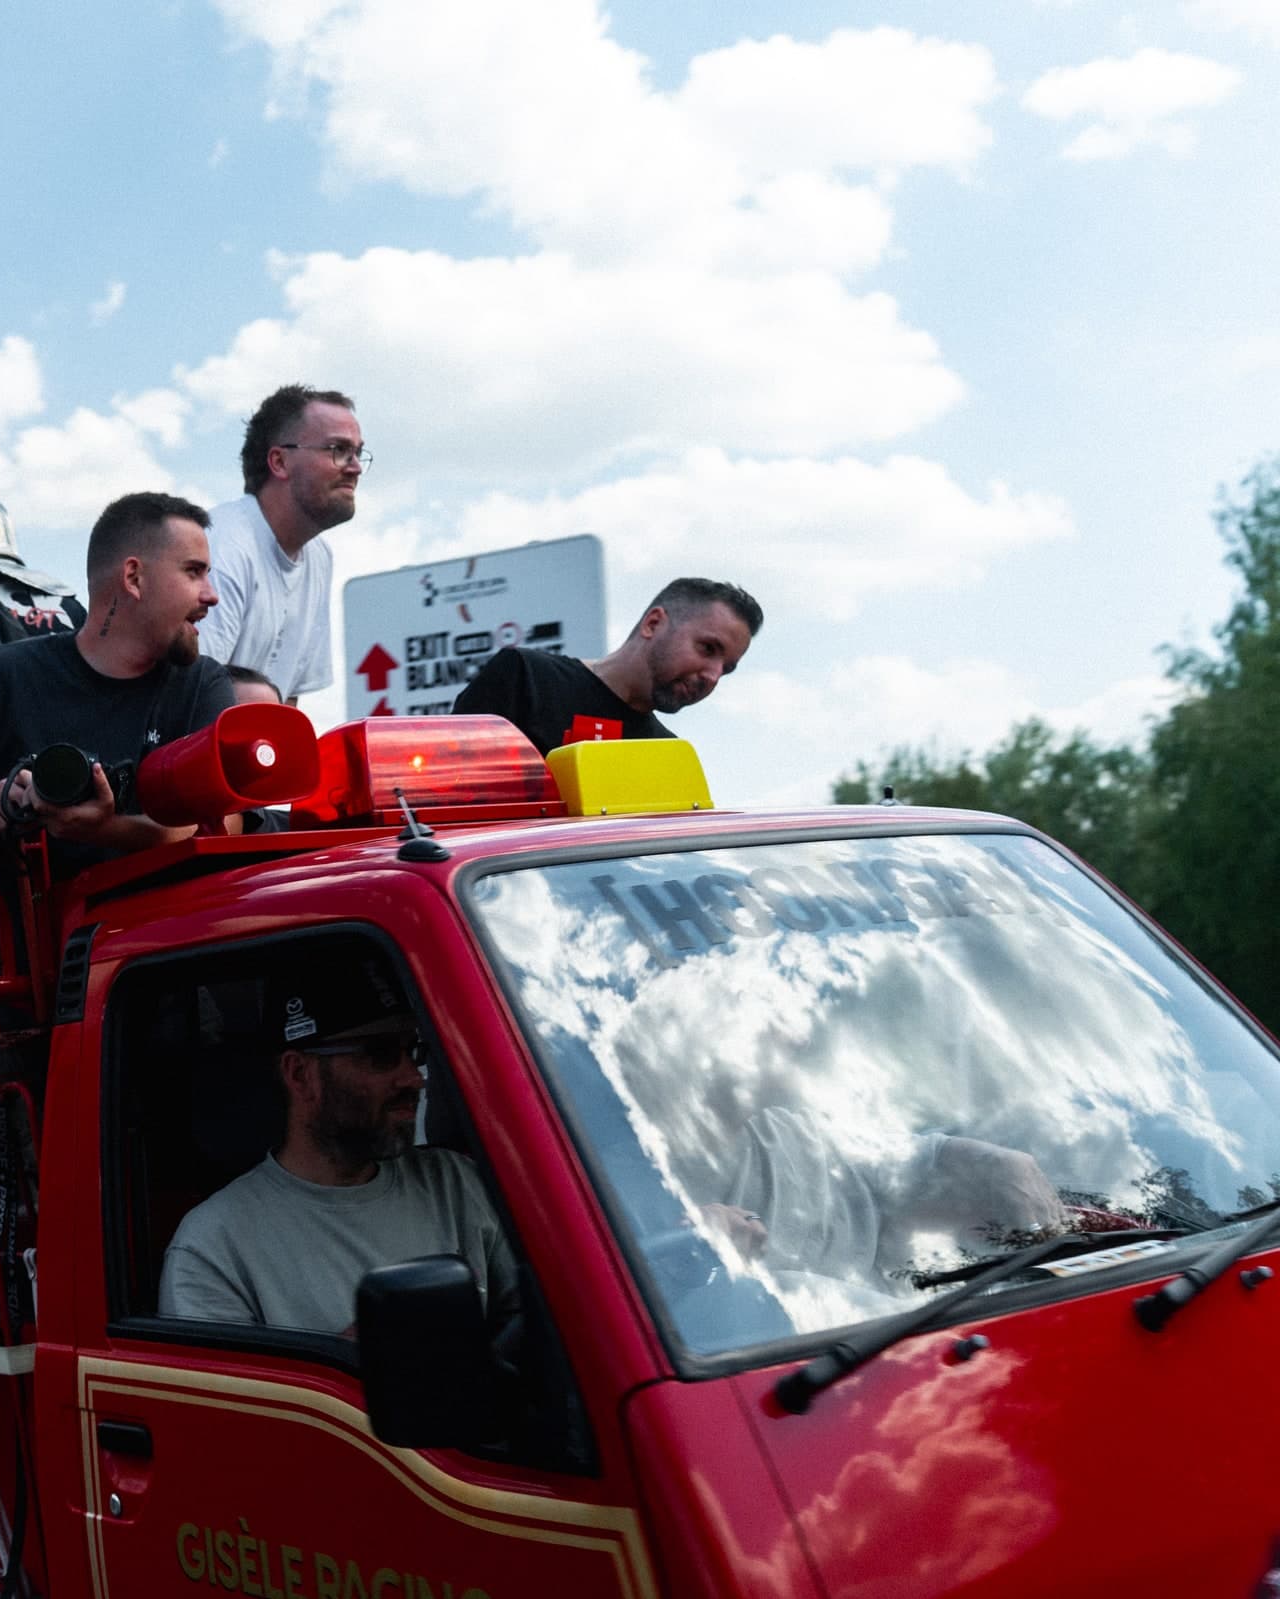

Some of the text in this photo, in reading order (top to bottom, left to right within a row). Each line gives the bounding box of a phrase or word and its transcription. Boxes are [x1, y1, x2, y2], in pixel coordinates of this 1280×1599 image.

[406, 631, 450, 663] EXIT
[176, 1517, 493, 1599] GISÈLE RAC
